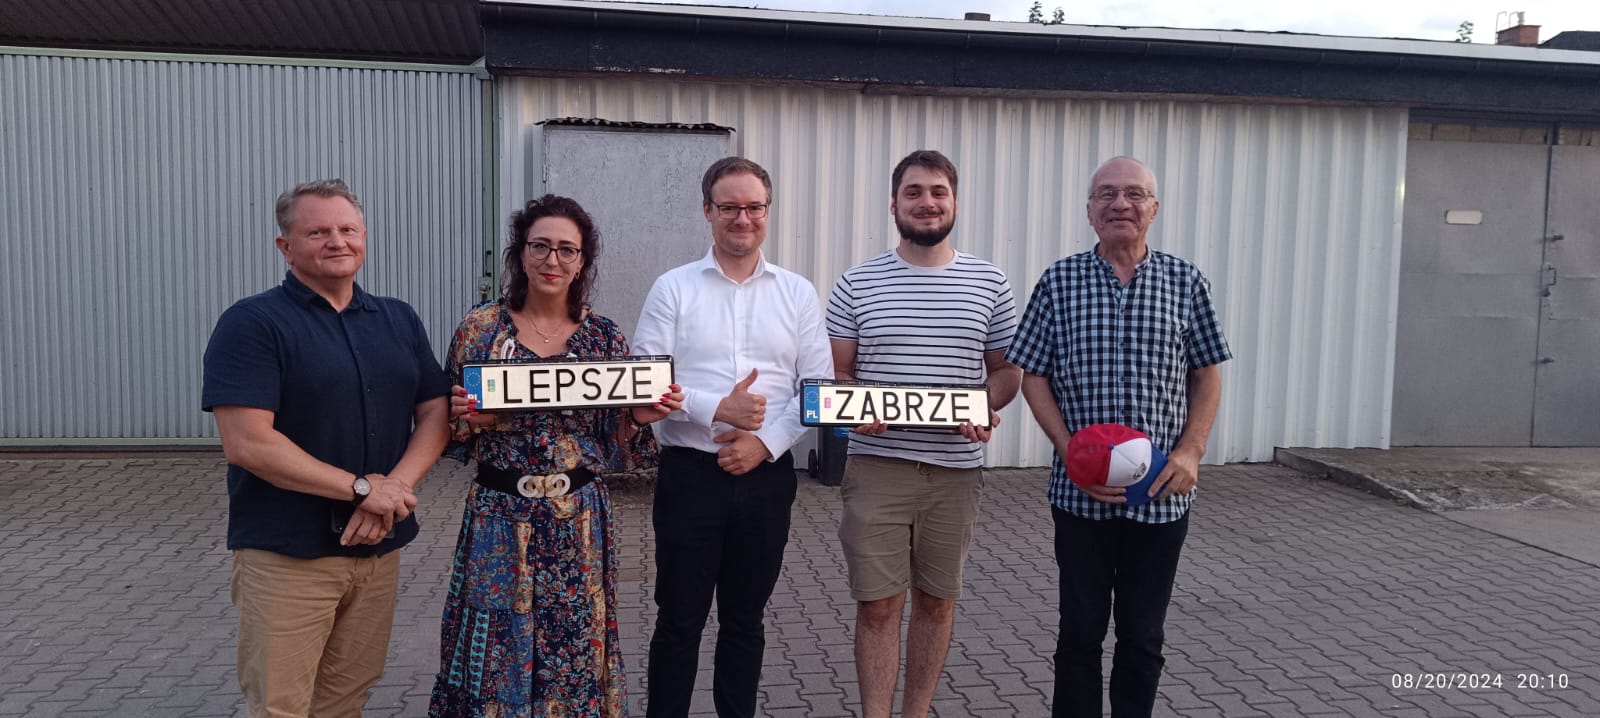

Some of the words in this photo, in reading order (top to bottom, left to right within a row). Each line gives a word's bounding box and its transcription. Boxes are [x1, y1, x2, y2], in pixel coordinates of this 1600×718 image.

[502, 366, 652, 404] LEPSZE
[806, 409, 819, 419] PL
[835, 390, 971, 423] ZABRZE
